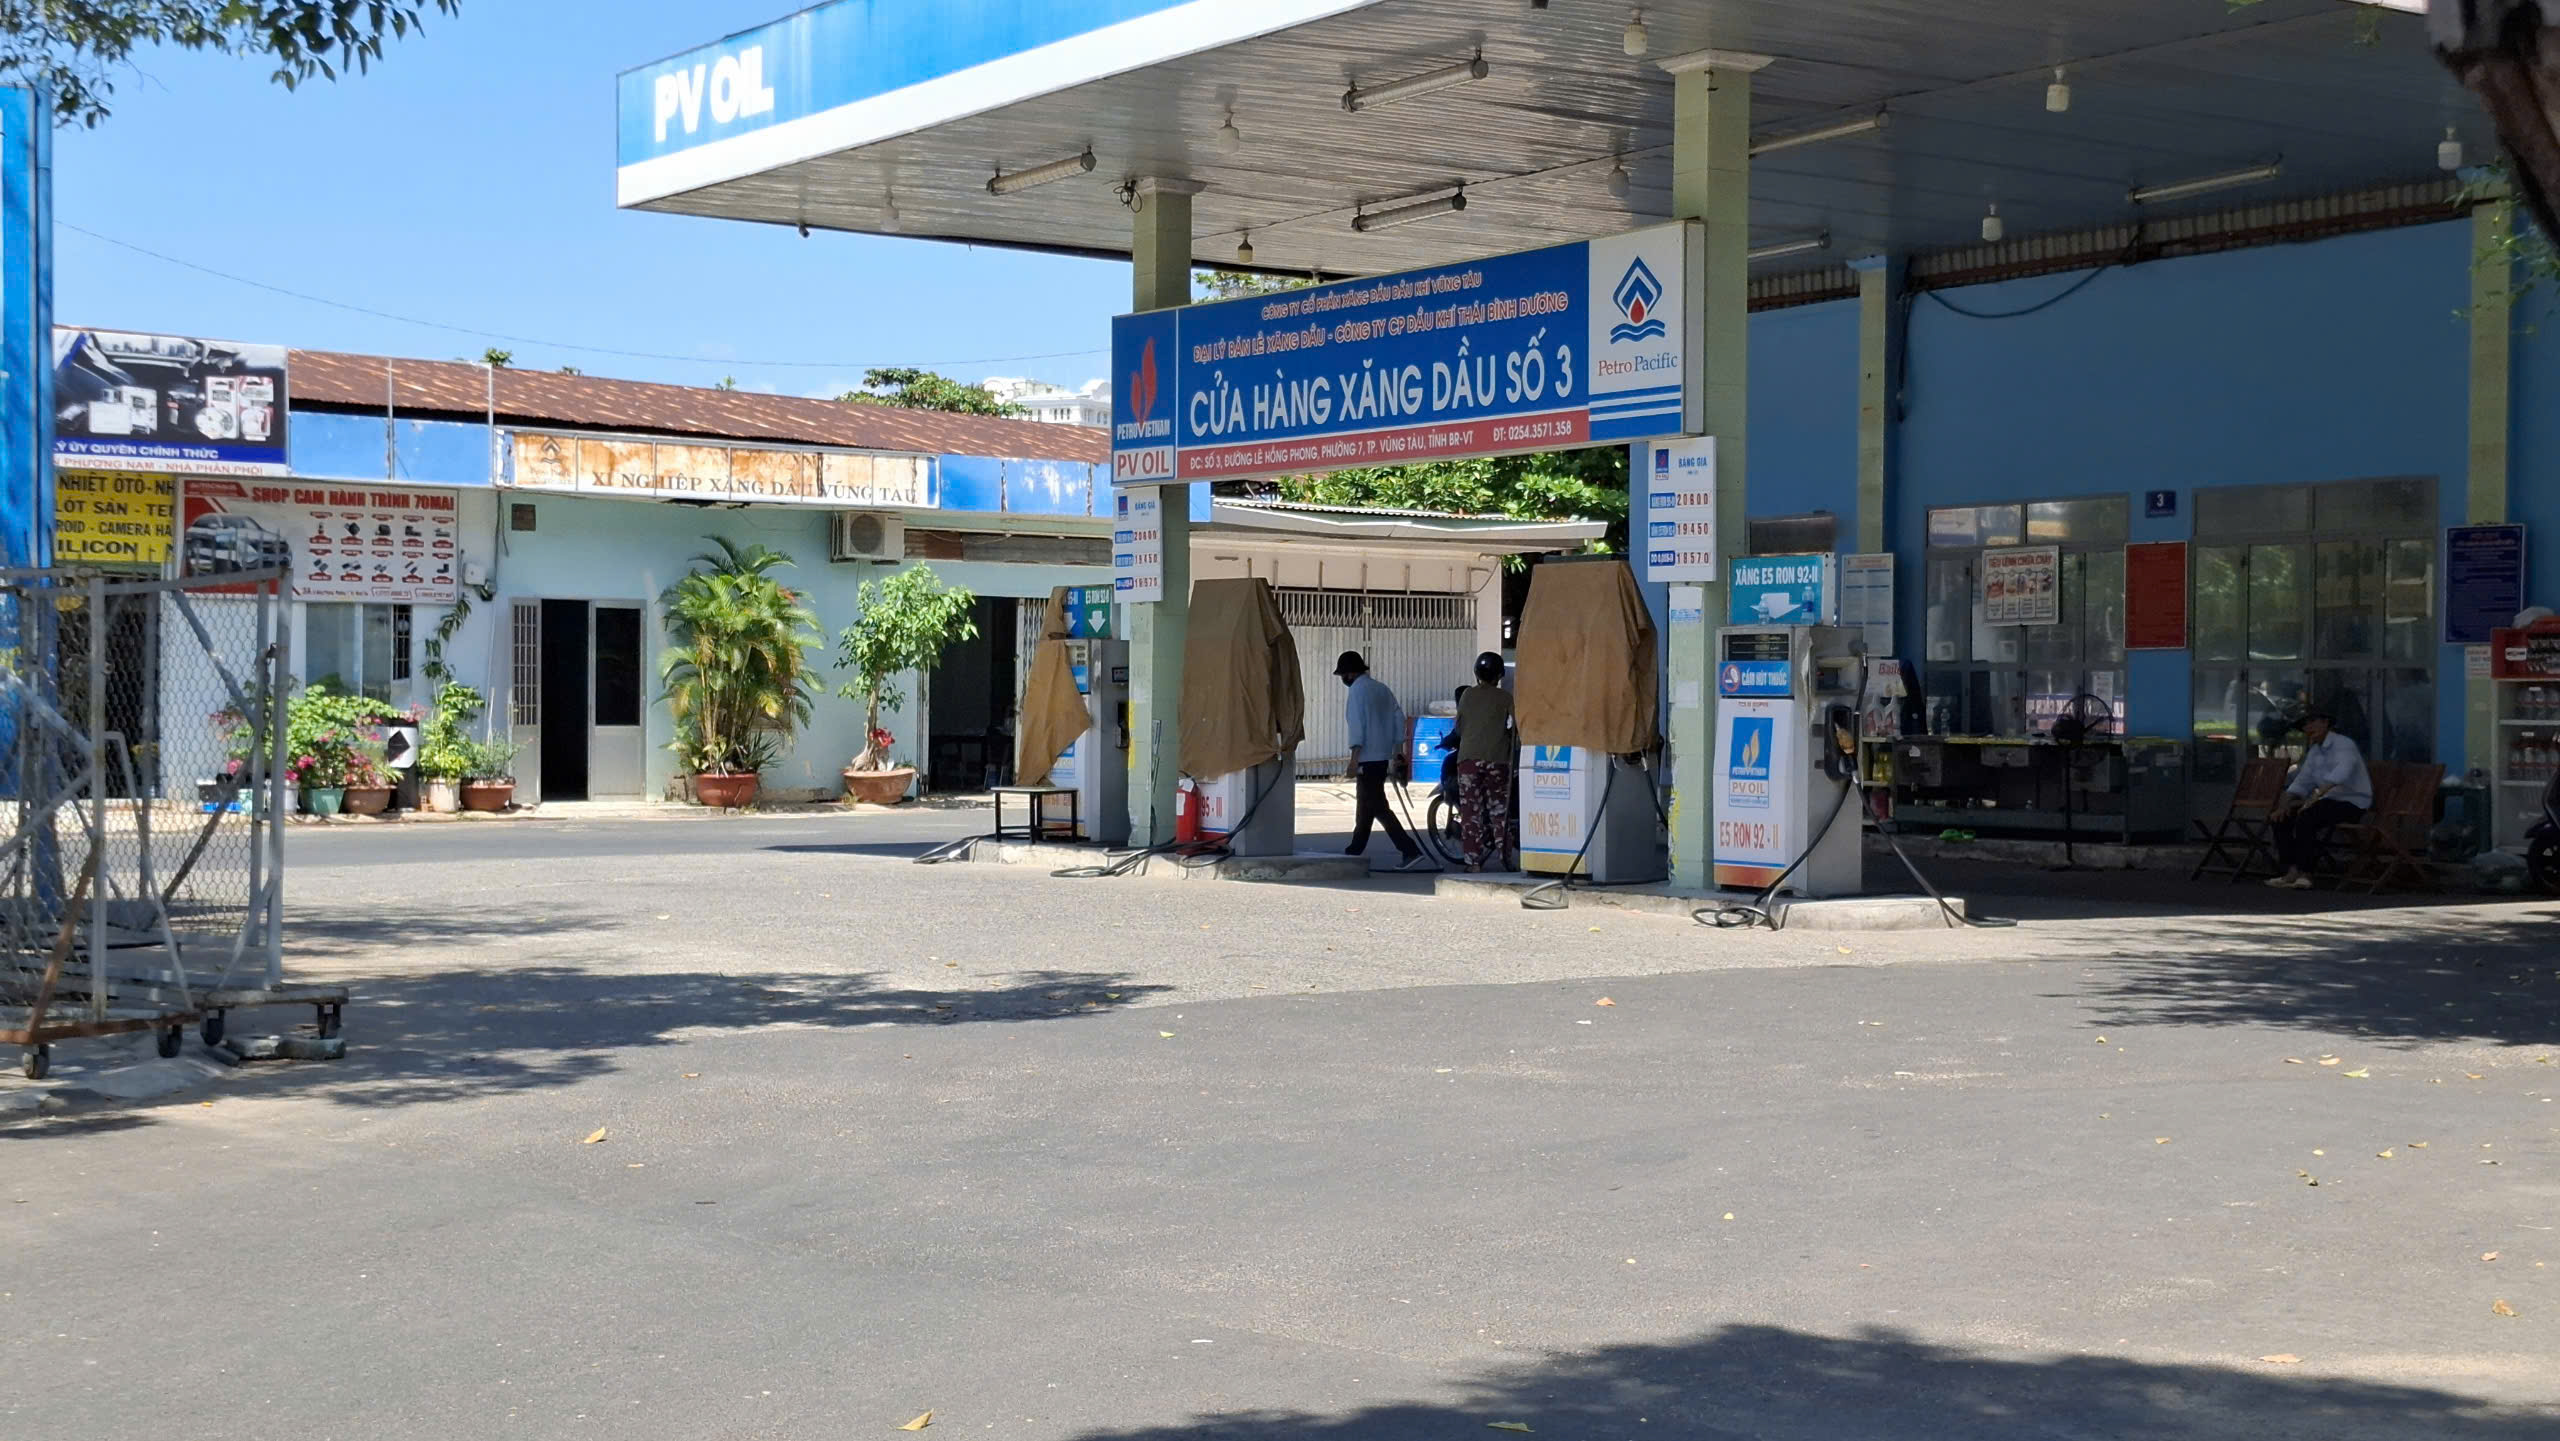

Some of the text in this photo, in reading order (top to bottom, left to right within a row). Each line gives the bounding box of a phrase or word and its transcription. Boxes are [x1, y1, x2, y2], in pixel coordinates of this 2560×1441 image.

[655, 46, 774, 142] PV OIL
[1261, 303, 1288, 320] CÔNG
[1289, 301, 1300, 317] TY
[1414, 277, 1431, 296] KHÍ
[1431, 275, 1461, 294] VŨNG
[1228, 335, 1250, 358] BÁN
[1335, 320, 1371, 344] CÔNG
[1371, 319, 1386, 339] TY
[1388, 316, 1406, 336] CP
[1435, 303, 1457, 329] KHÍ
[1457, 300, 1486, 326] THÁI
[1487, 297, 1517, 322] BÌNH
[1519, 291, 1569, 318] DƯƠNG
[1598, 352, 1678, 377] Petro Pacific
[1190, 327, 1573, 437] CỬA HÀNG XĂNG DẦU SỐ 3
[1117, 419, 1170, 440] PETROVIETNAM
[1493, 420, 1572, 442] ĐT: 0254.3571.358
[139, 445, 180, 457] CHÍNH
[182, 447, 219, 459] THỨC
[1204, 451, 1215, 469] SỐ
[1216, 456, 1223, 470] 3,
[1224, 449, 1252, 468] ĐƯỜNG
[1254, 448, 1263, 465] LÊ
[1264, 445, 1288, 463] HỒNG
[1321, 440, 1356, 458] PHƯỜNG
[1379, 435, 1405, 453] VŨNG
[1428, 429, 1447, 448] TỈNH
[1449, 430, 1474, 446] BR-VT
[127, 459, 155, 470] NAM
[1117, 450, 1169, 477] PV OIL
[59, 472, 107, 495] NHIỆT
[93, 498, 128, 516] SÀN
[252, 486, 290, 503] SHOP
[294, 488, 324, 505] CAM
[329, 488, 366, 507] HÀNH
[370, 490, 410, 508] TRÌNH
[414, 494, 454, 511] 70MAI
[2156, 493, 2164, 507] 3
[99, 521, 152, 536] CAMERA
[1677, 522, 1708, 535] 19450
[1677, 552, 1709, 564] 18570
[1761, 567, 1774, 584] E5
[1775, 566, 1795, 584] RON
[1536, 775, 1568, 786] PV OIL
[1732, 782, 1765, 794] PV OIL
[1528, 812, 1546, 836] RON
[1548, 812, 1560, 837] 95
[1568, 813, 1577, 837] III
[1719, 821, 1731, 847] E5
[1733, 822, 1750, 849] RON
[1753, 823, 1764, 849] 92
